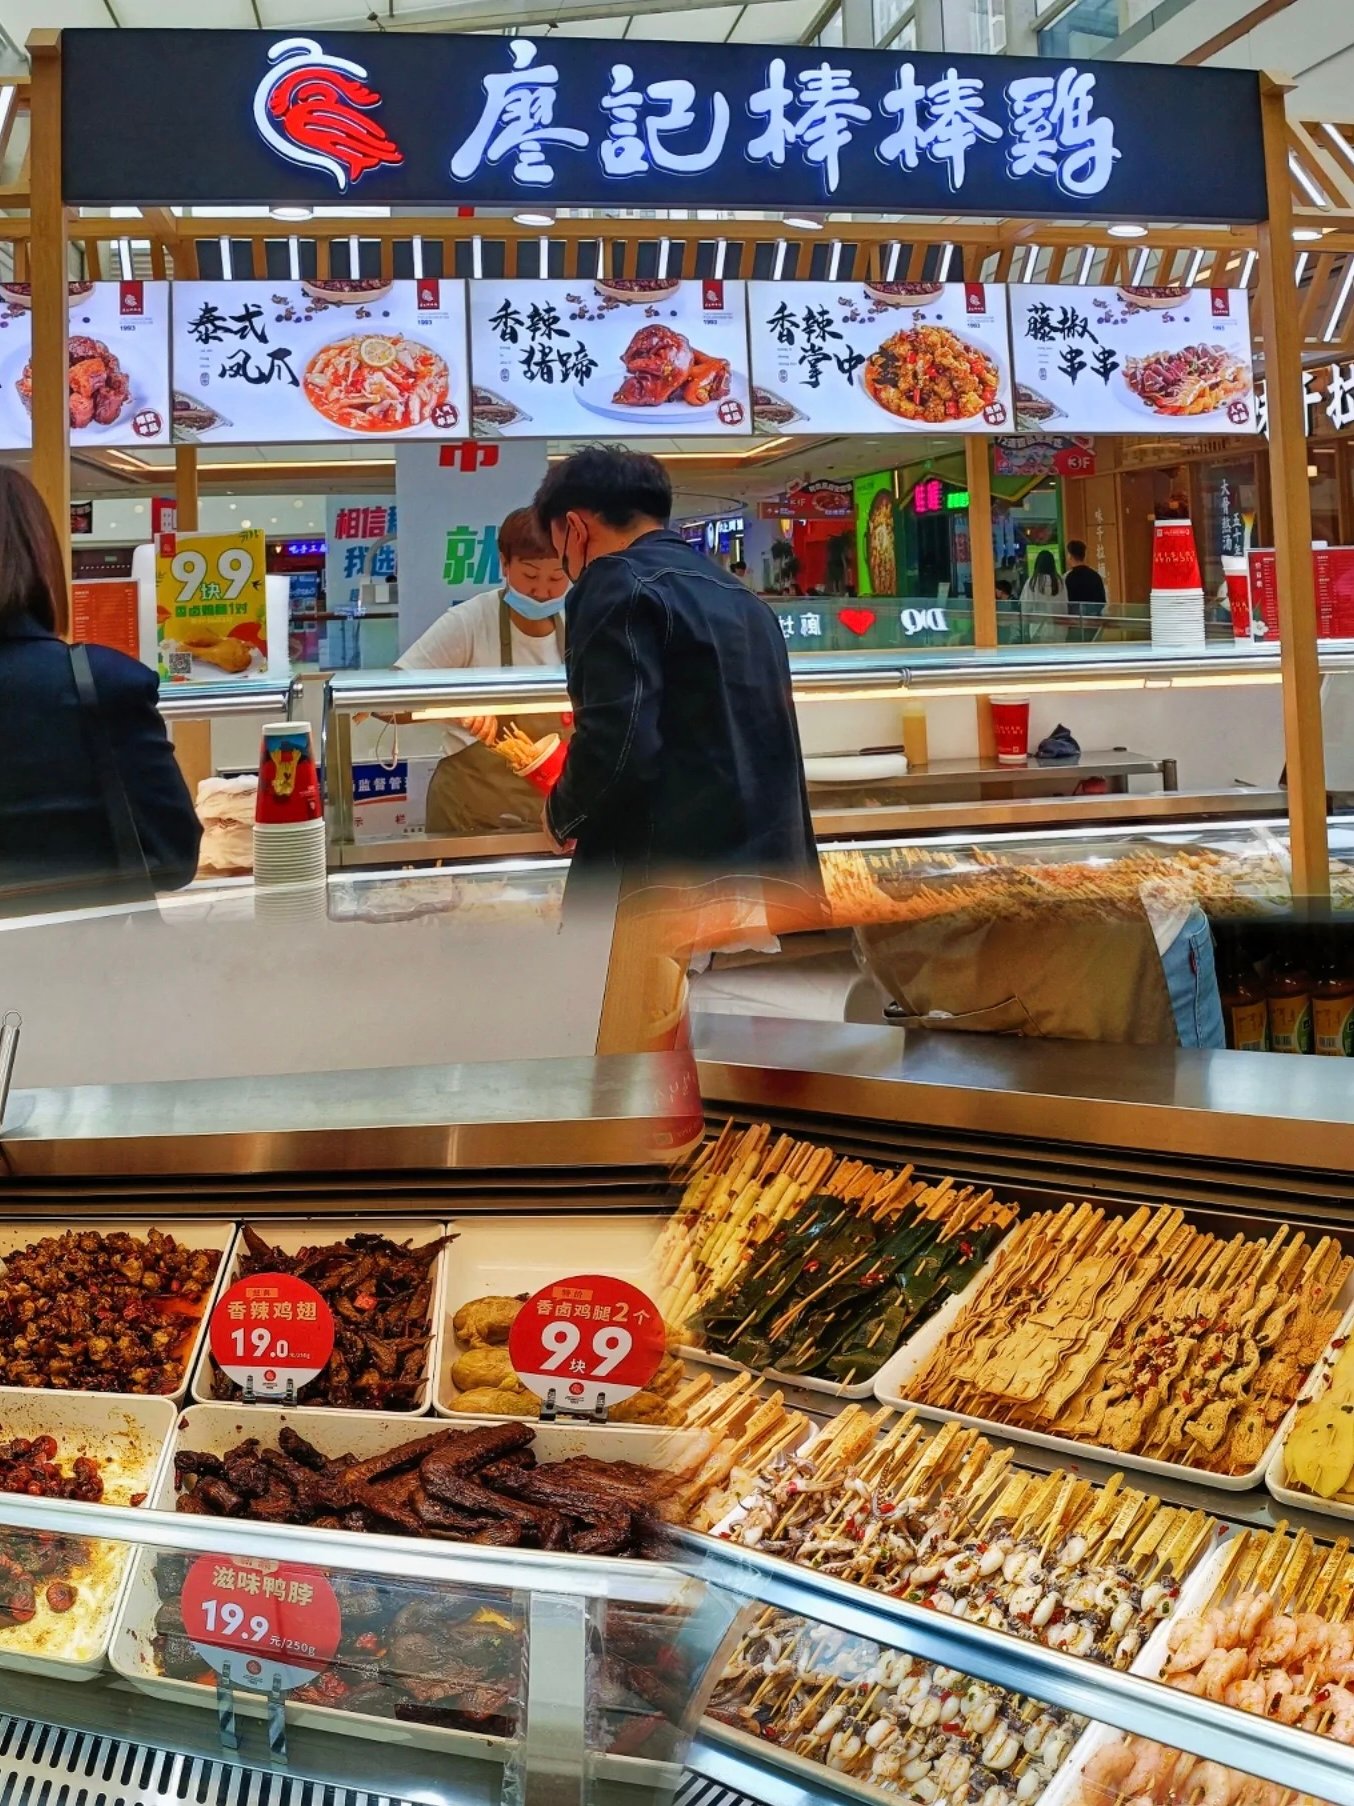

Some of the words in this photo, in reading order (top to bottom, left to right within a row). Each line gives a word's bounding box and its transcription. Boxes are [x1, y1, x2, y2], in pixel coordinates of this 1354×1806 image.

[187, 301, 269, 345] 泰式
[488, 298, 571, 345] 香辣
[766, 300, 844, 346] 香辣
[1024, 301, 1099, 345] 藤椒
[217, 347, 300, 387] 凤爪
[518, 340, 599, 387] 猪蹄
[1056, 344, 1120, 387] 串串
[227, 1300, 318, 1321] 香辣鸡翅
[536, 1299, 651, 1326] 香卤鸡腿2个
[231, 1327, 289, 1358] 19.0
[211, 1565, 315, 1607] 滋味鸭脖
[201, 1599, 270, 1643] 19.9
